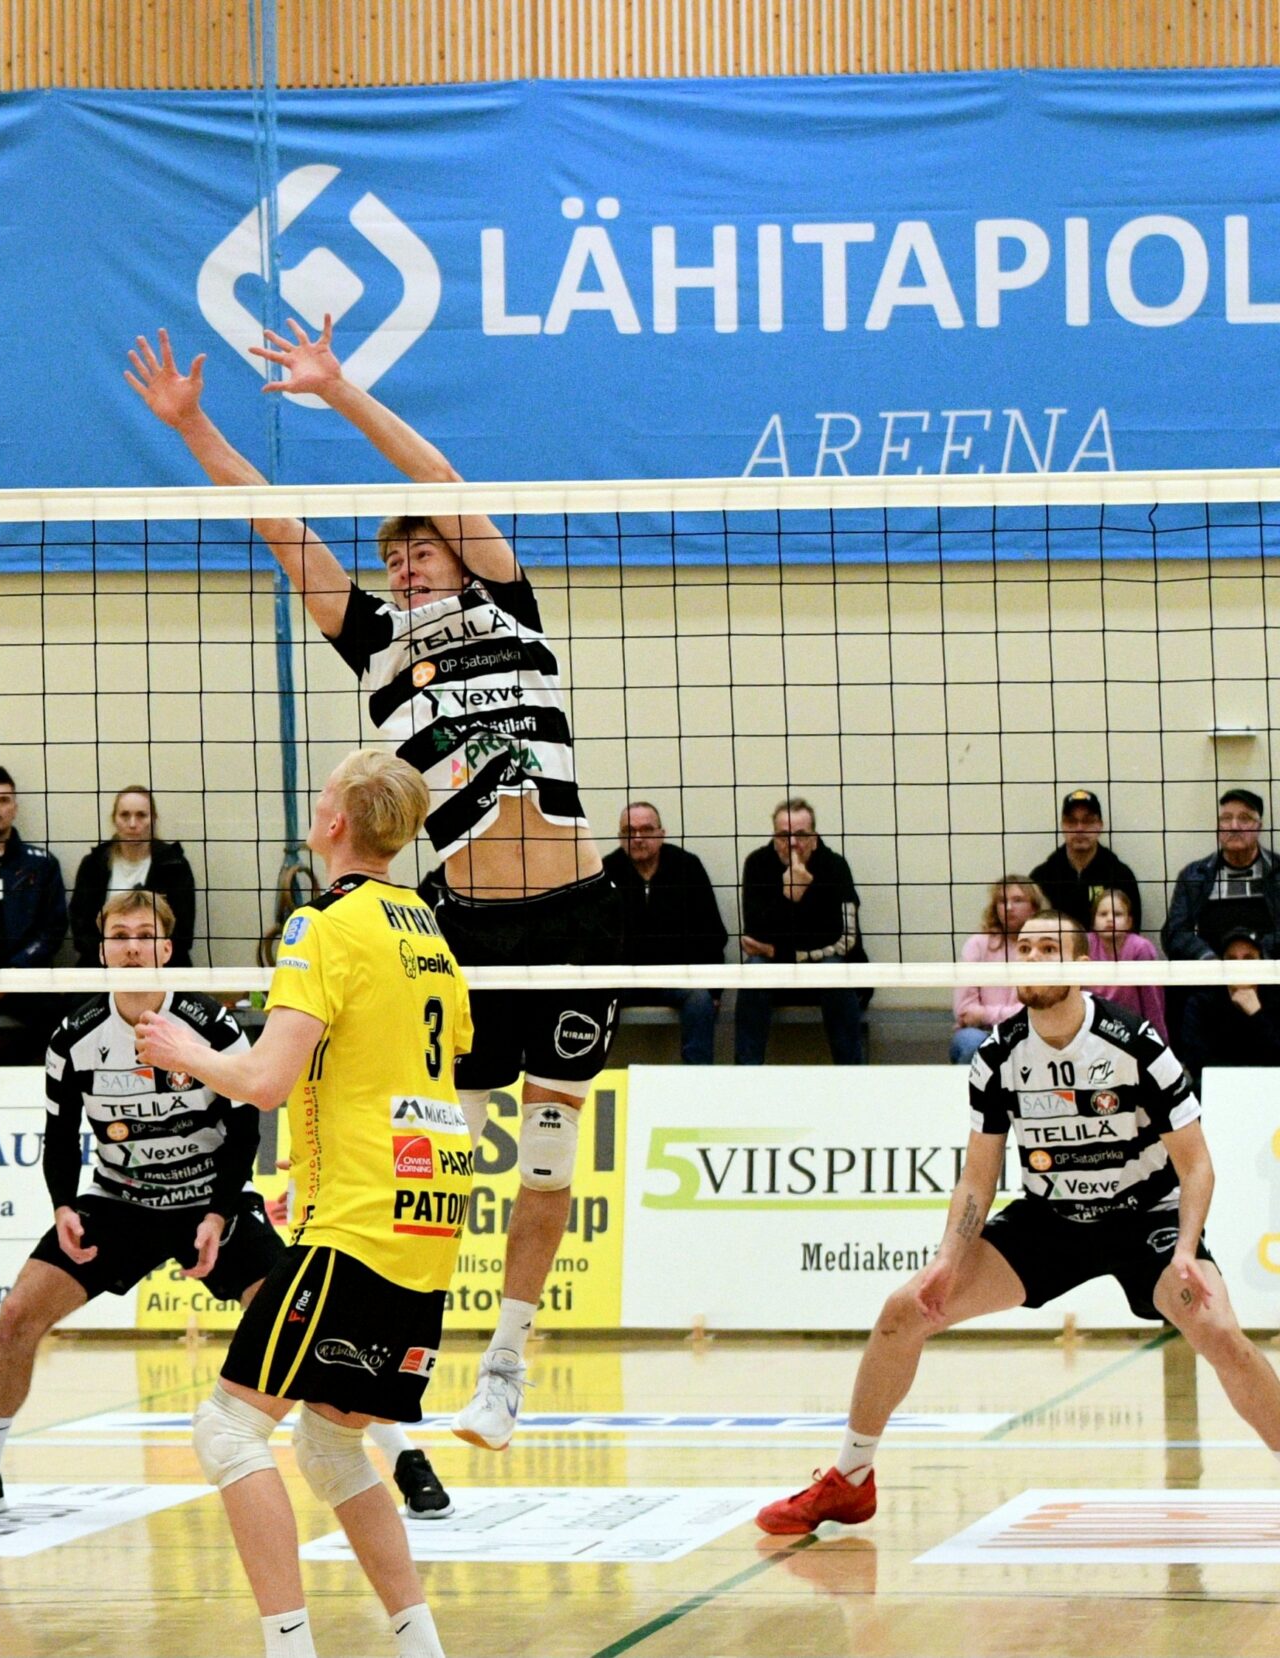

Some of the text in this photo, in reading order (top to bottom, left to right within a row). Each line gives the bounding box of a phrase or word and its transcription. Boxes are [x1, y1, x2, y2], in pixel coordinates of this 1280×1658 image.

[740, 405, 1120, 477] AREENA
[403, 608, 512, 655] TELILÄ
[439, 659, 458, 673] OP
[452, 684, 525, 709] Vexve
[423, 996, 444, 1083] 3
[562, 1029, 595, 1041] KIRAMI
[1047, 1060, 1076, 1087] 10
[101, 1095, 189, 1119] TELILÄ
[1024, 1119, 1118, 1143] TELILÄ
[140, 1141, 200, 1162] Vexve
[1064, 1178, 1121, 1195] Vexve
[146, 1292, 246, 1312] Air-Cran
